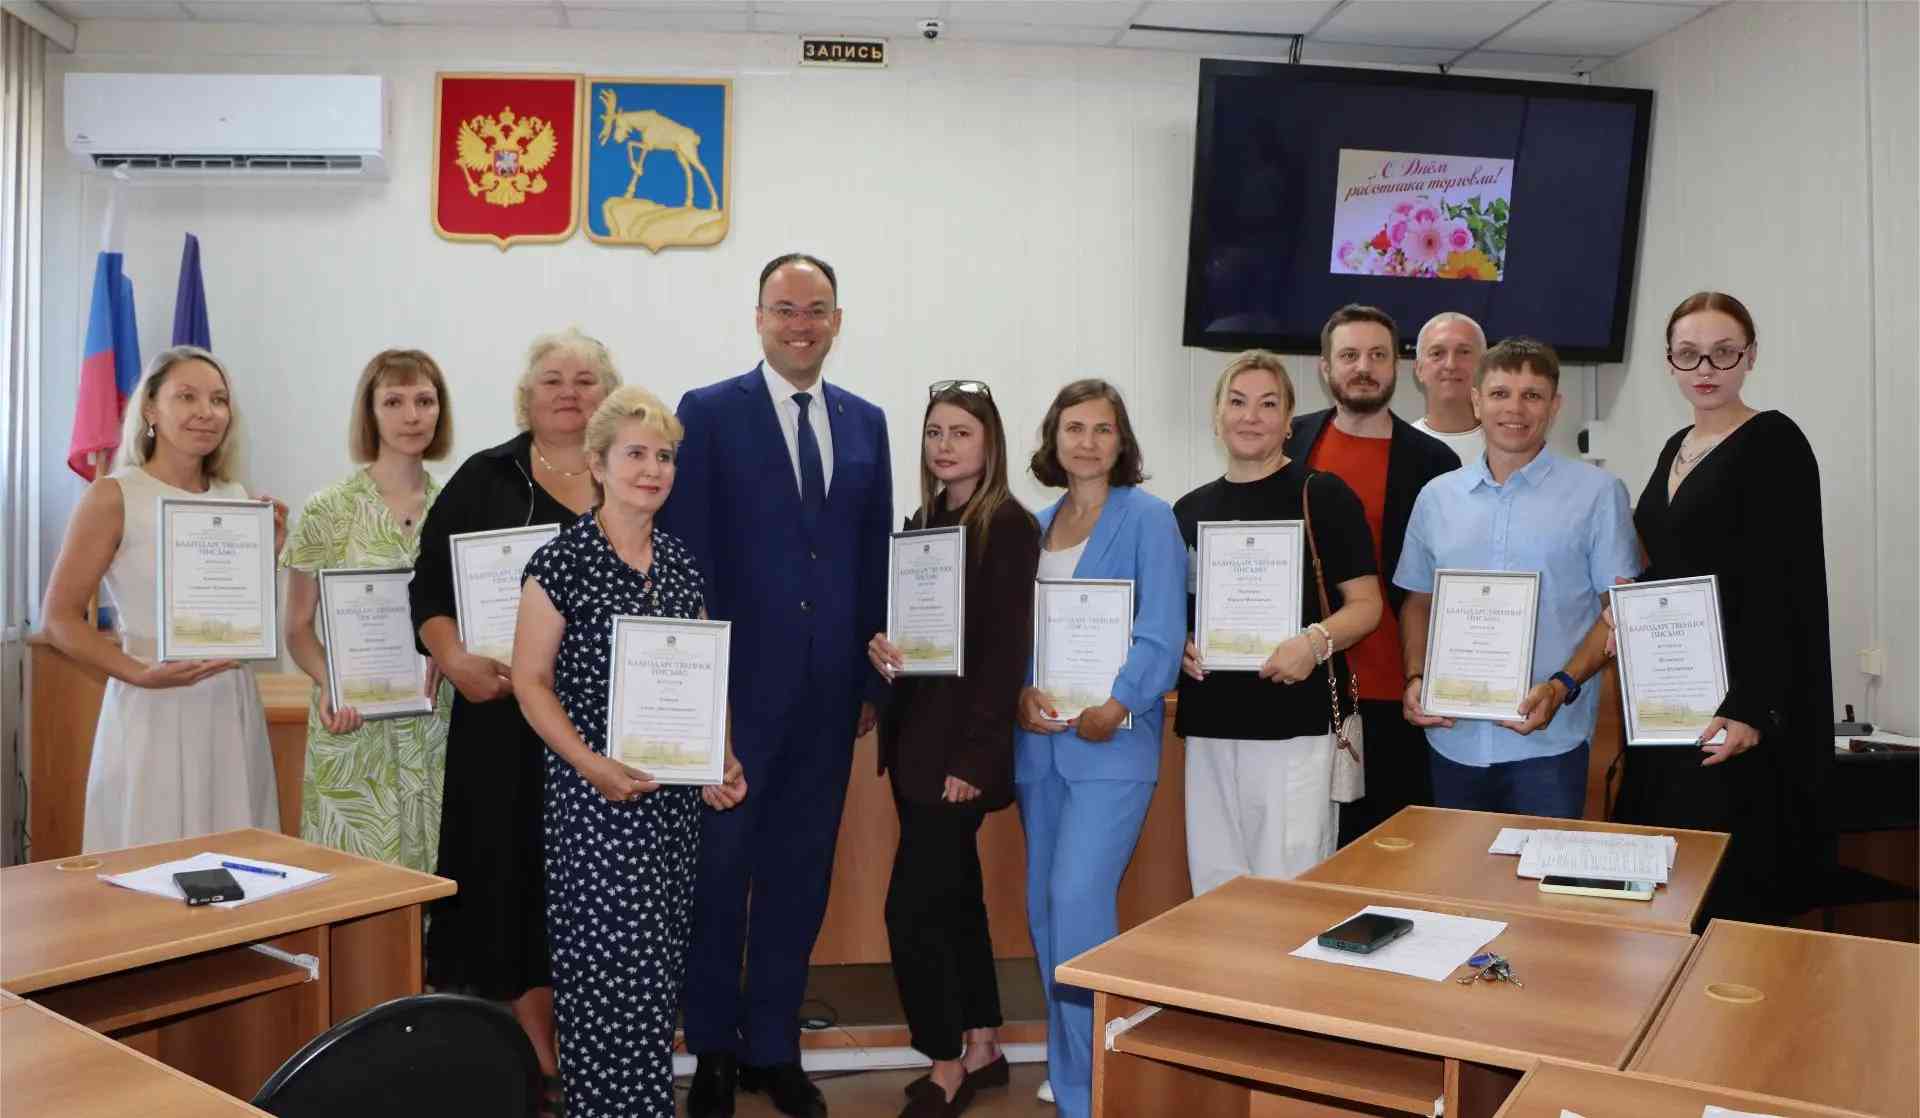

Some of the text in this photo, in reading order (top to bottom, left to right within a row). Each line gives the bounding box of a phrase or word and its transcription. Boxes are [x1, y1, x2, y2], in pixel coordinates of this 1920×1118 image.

[805, 44, 882, 59] ЗАПИСЬ
[1381, 159, 1449, 178] С Днём
[1344, 165, 1504, 201] работника торговли!
